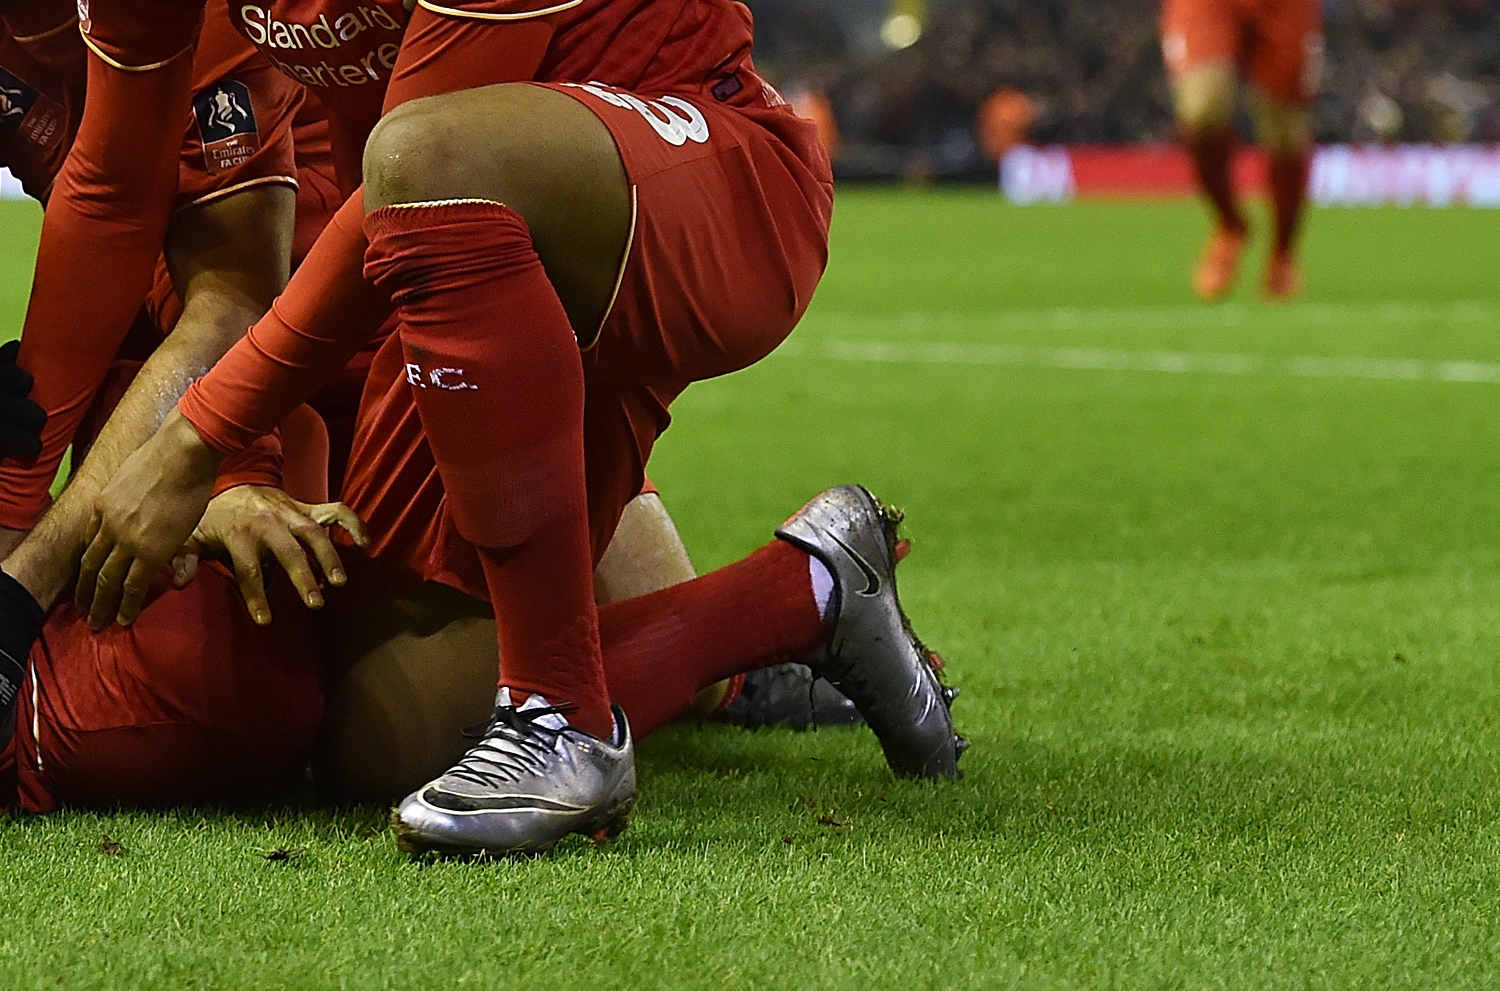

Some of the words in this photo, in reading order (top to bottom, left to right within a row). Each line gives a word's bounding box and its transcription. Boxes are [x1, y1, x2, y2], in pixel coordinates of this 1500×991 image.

[241, 5, 401, 49] Standard
[266, 42, 400, 87] hartere
[212, 146, 255, 160] Emirates
[220, 159, 233, 168] FA
